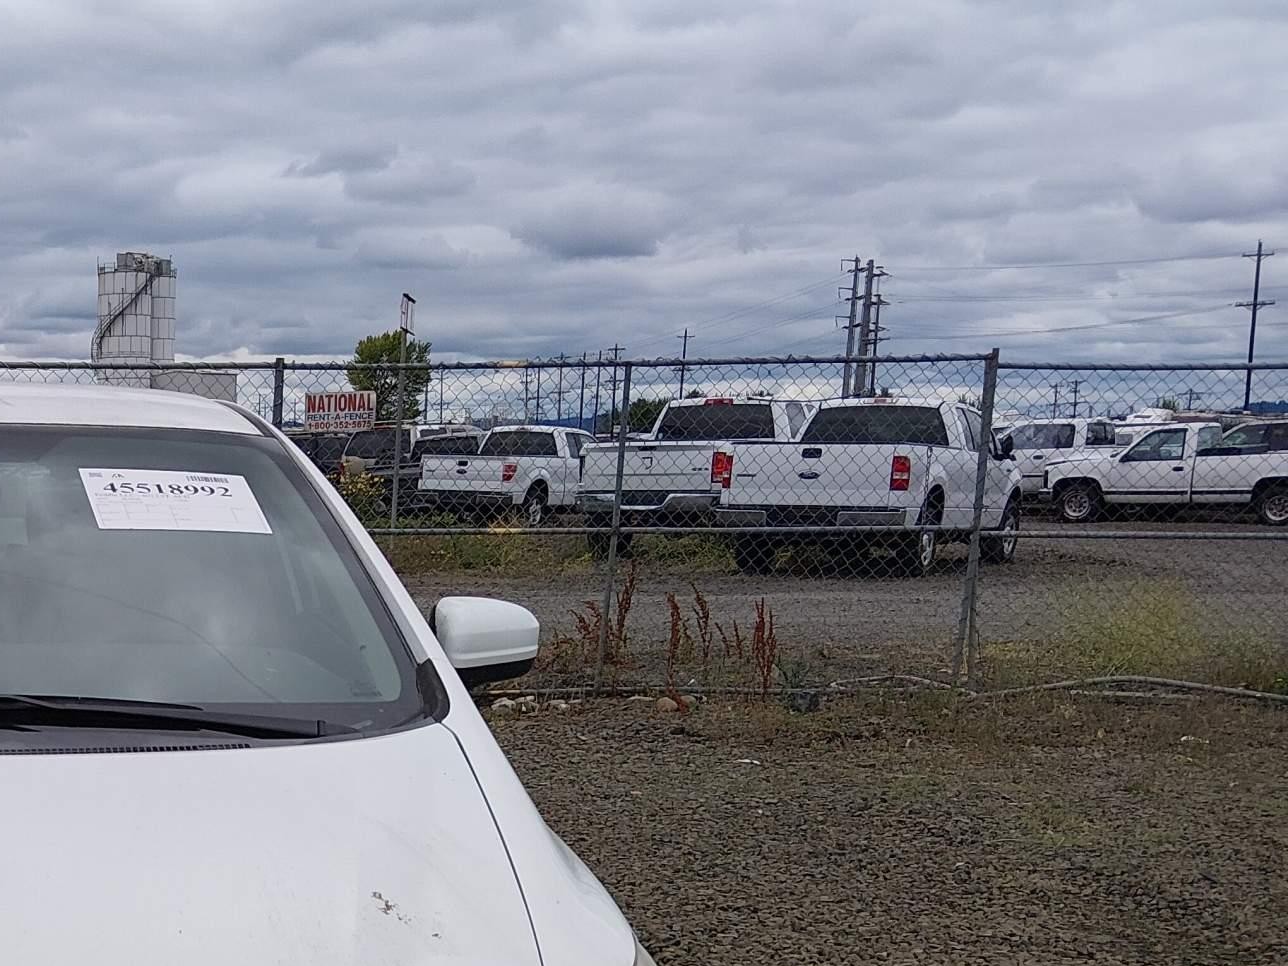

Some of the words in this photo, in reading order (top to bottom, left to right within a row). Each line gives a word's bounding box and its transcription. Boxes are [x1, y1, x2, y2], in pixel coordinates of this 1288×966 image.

[306, 393, 374, 413] NATIONAL
[307, 412, 373, 421] RENT-A-FENCE
[103, 482, 233, 498] 45518992
